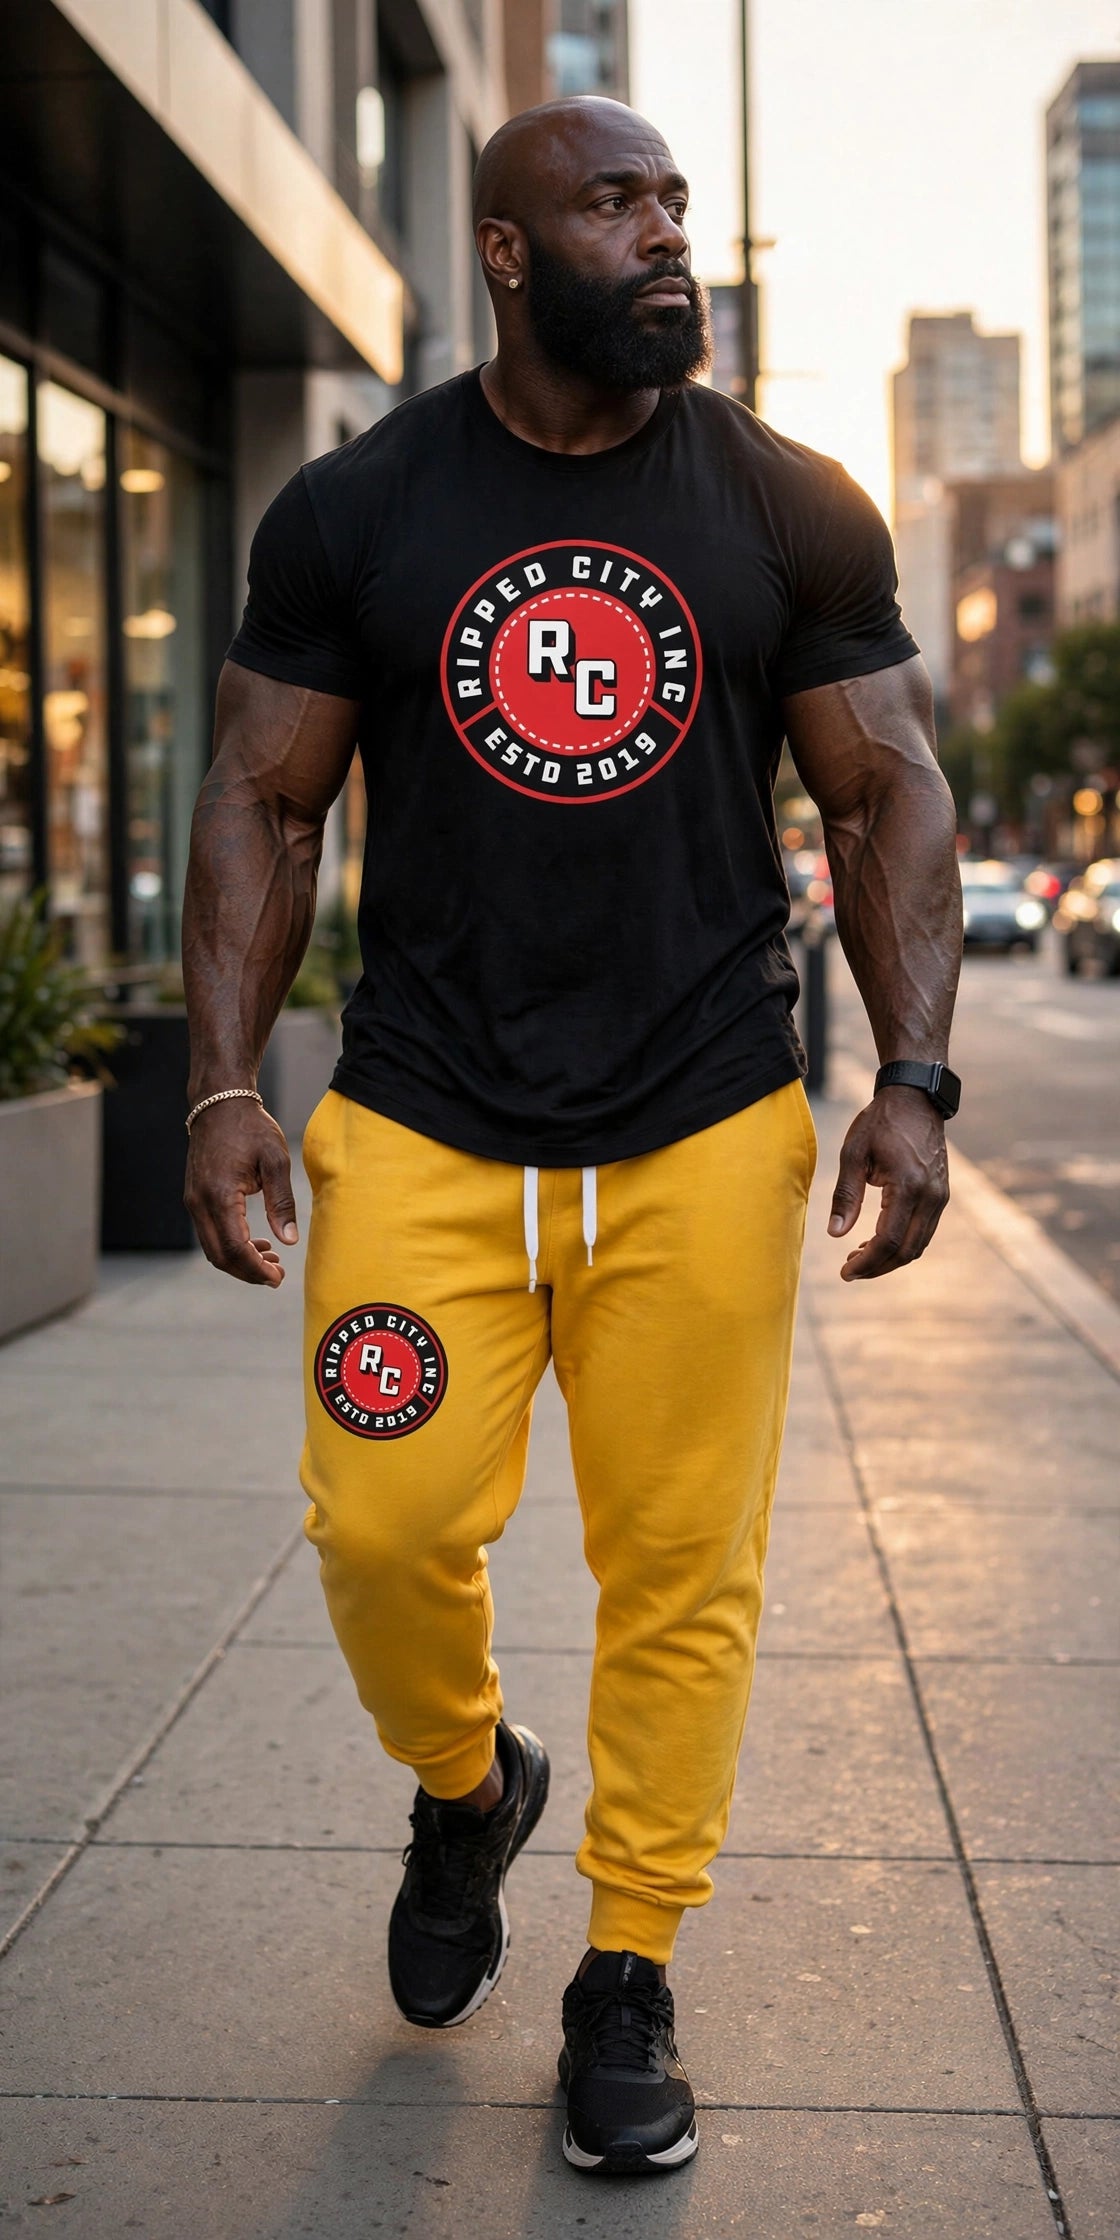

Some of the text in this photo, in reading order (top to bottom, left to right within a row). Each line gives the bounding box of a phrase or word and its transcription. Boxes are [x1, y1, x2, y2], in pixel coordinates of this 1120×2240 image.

[456, 555, 687, 703] RIPPED CITY INC
[528, 619, 617, 719] RC
[484, 727, 656, 785] ESTD 2019
[326, 1315, 437, 1394] RIPPED CITY INC
[360, 1344, 401, 1396] RC
[335, 1394, 417, 1427] ESTD 2019
